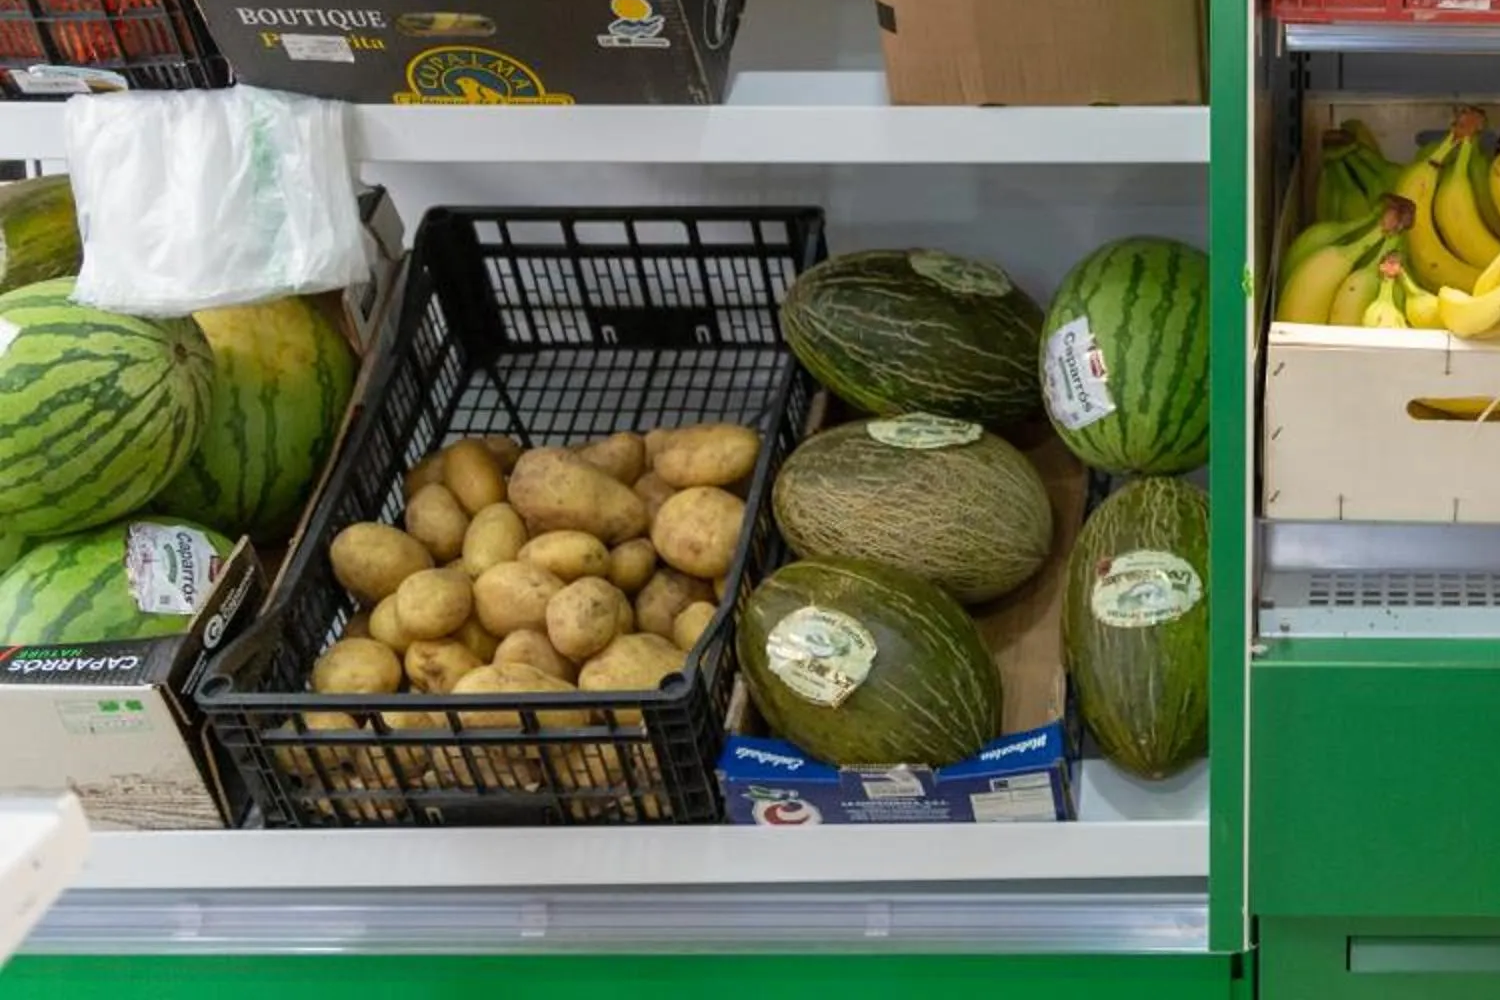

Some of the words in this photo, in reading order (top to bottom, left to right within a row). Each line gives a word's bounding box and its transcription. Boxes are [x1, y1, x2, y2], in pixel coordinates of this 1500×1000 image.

[236, 7, 387, 30] BOUTIQUE
[176, 532, 194, 605] Caparrós
[8, 655, 138, 673] CAPARRÓS
